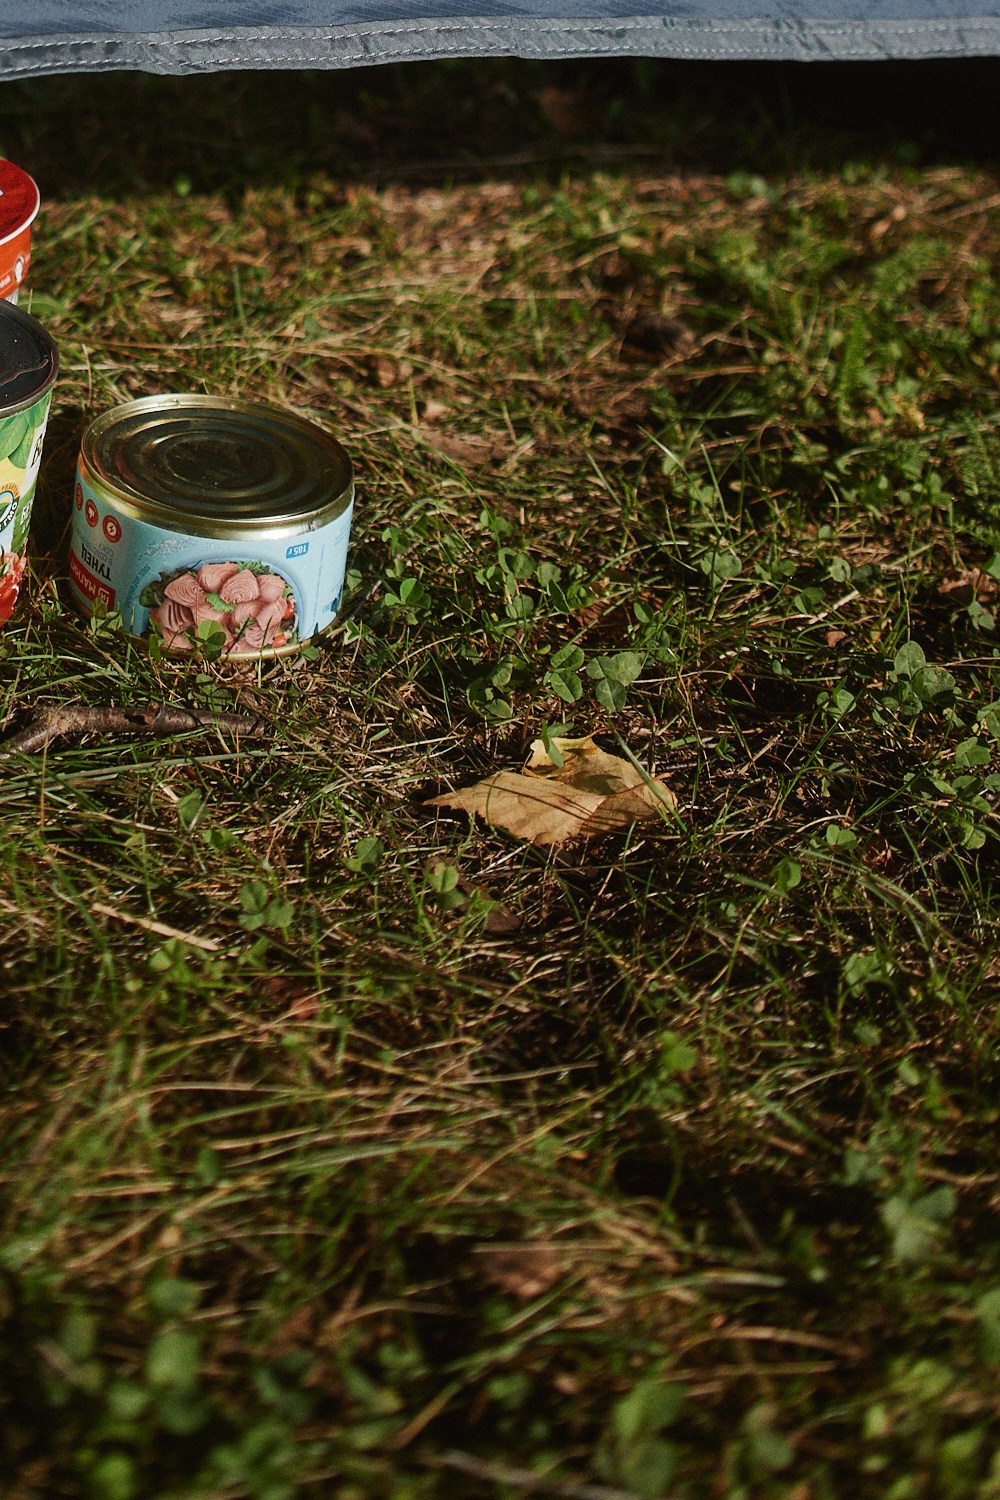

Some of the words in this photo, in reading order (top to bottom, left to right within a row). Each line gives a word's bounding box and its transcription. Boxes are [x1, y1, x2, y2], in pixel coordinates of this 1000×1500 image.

[3, 501, 18, 527] ГМО
[81, 543, 112, 582] ТУНЕЦ
[293, 544, 307, 556] 185
